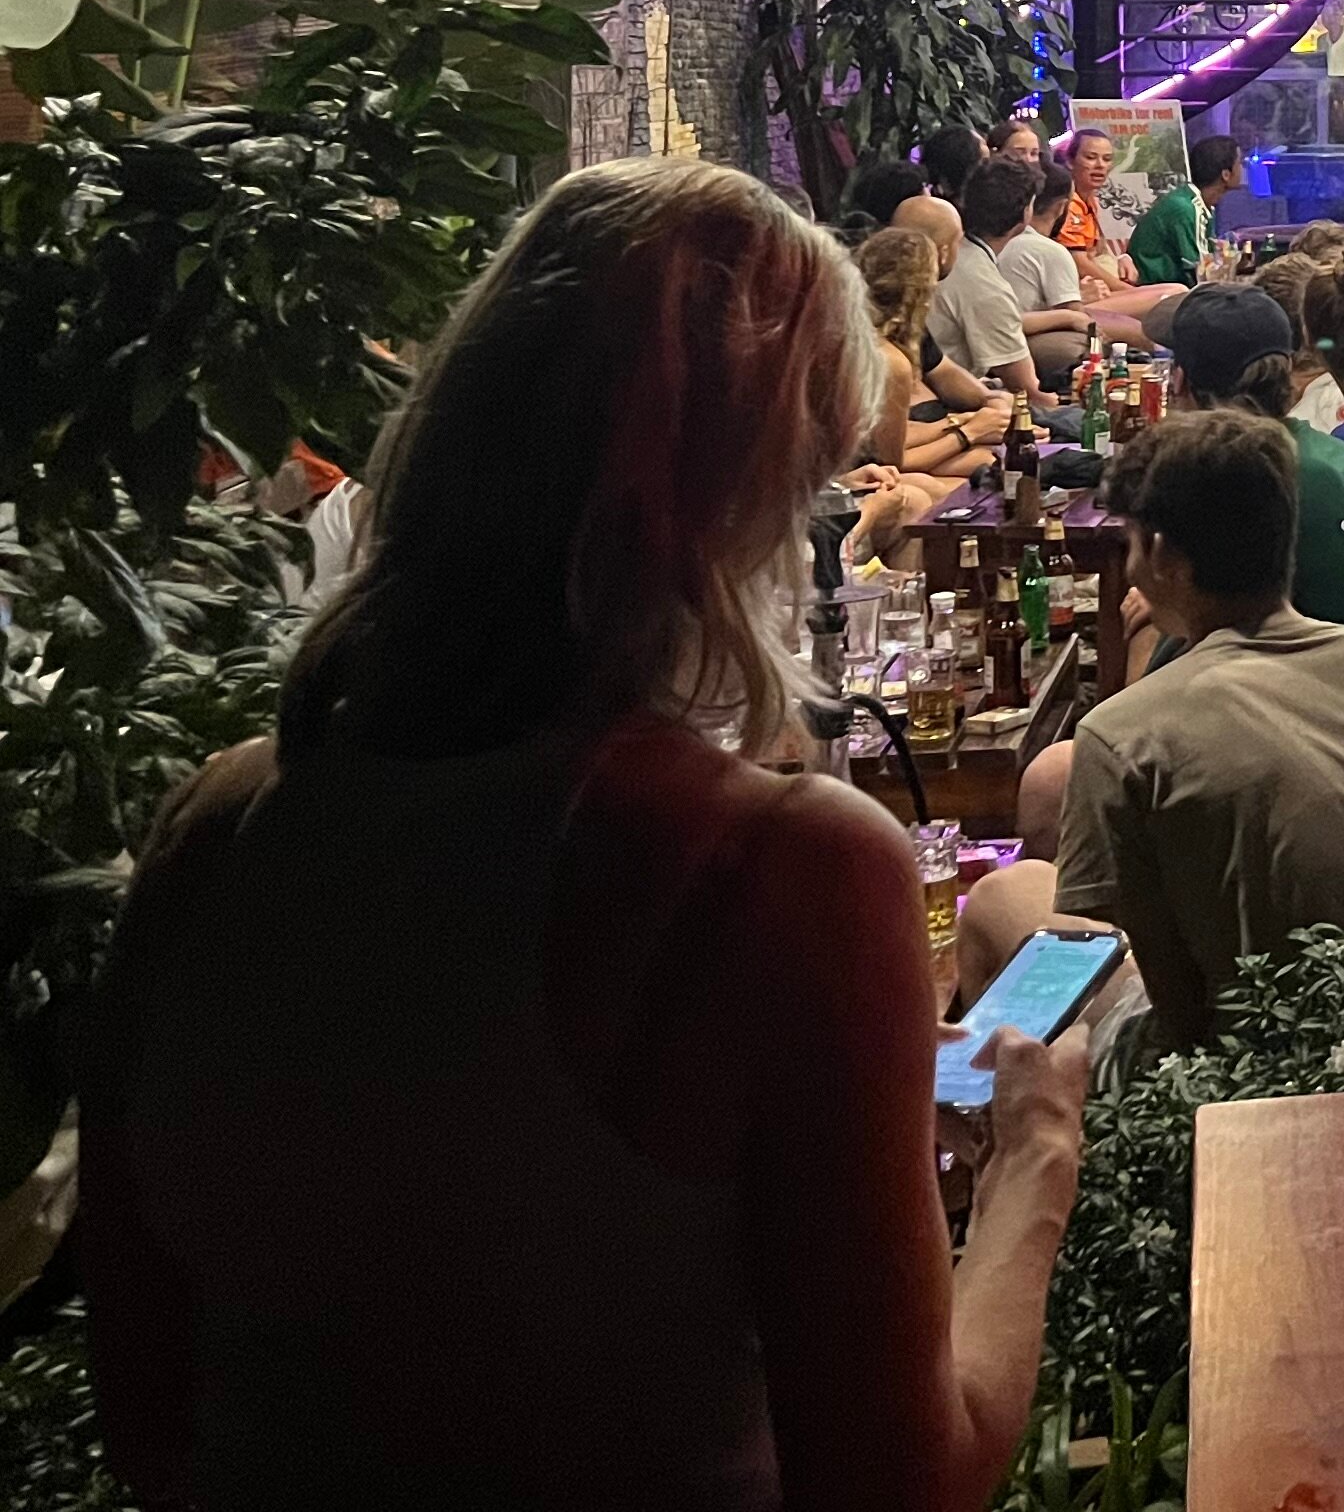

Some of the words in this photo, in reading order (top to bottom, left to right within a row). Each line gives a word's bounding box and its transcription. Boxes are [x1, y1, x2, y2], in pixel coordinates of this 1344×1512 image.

[1078, 106, 1133, 120] Motorbike
[1135, 107, 1150, 119] for
[1153, 107, 1173, 120] rent
